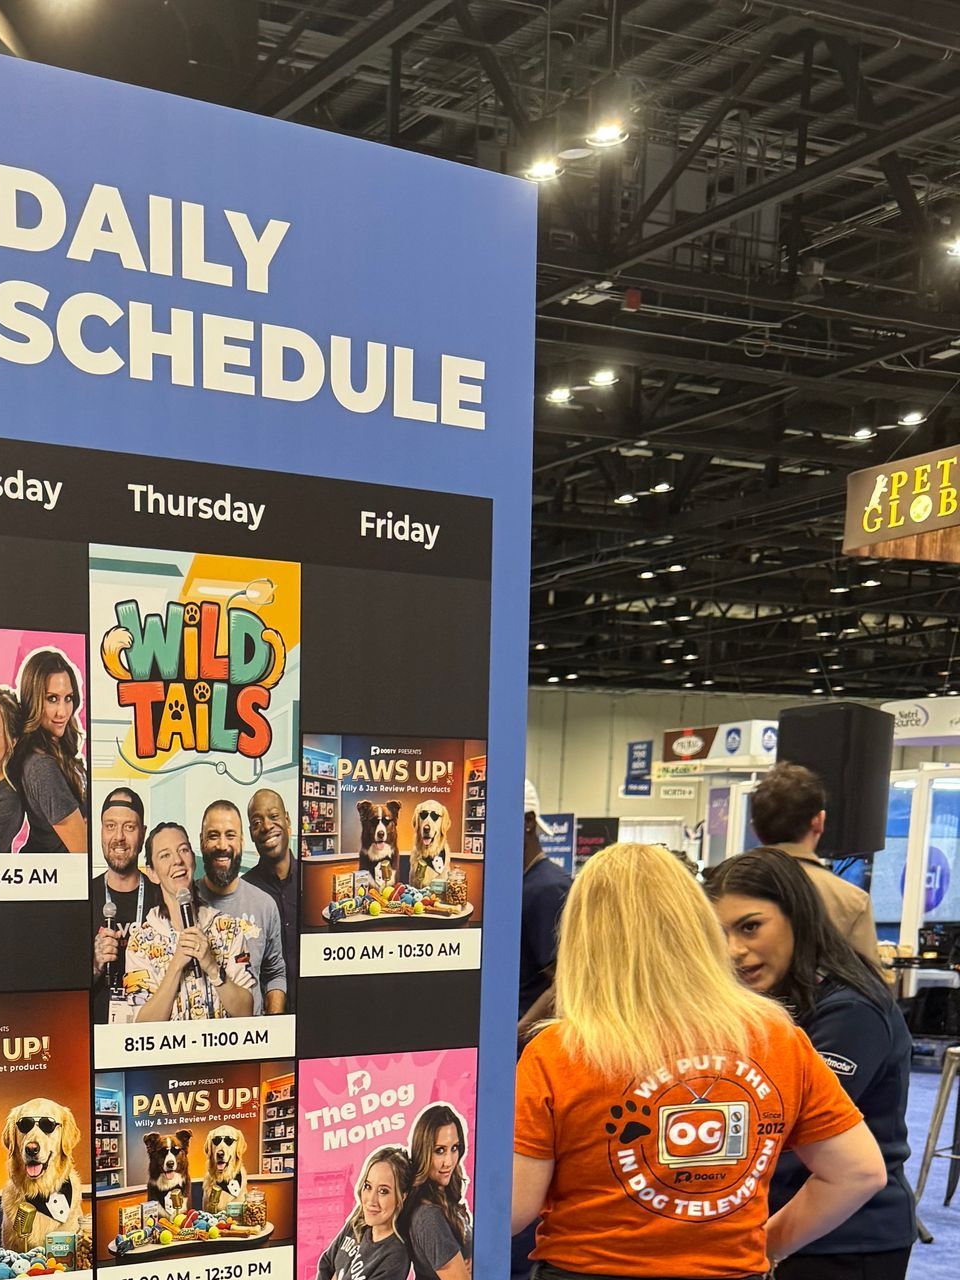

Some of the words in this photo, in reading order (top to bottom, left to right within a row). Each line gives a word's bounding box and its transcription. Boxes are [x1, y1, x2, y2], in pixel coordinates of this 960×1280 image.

[889, 457, 957, 500] PET
[128, 484, 265, 530] Thursday
[360, 510, 441, 549] Friday
[895, 718, 921, 728] ource
[337, 758, 409, 783] PAWS
[415, 760, 454, 785] UP!
[28, 868, 58, 885] AM
[323, 946, 356, 961] 9:00
[360, 945, 384, 960] AM
[397, 943, 434, 958] 10:30
[437, 942, 461, 957] AM
[3, 1036, 51, 1061] UP!
[124, 1036, 155, 1052] 8:15
[159, 1034, 186, 1050] AM
[201, 1031, 239, 1048] 11:00
[242, 1029, 268, 1045] AM
[10, 1063, 47, 1073] products
[634, 1067, 672, 1100] WE
[677, 1055, 727, 1075] PUT
[735, 1060, 771, 1100] THE
[132, 1089, 210, 1117] PAWS
[217, 1086, 260, 1110] UP!
[305, 1101, 357, 1131] The
[360, 1083, 415, 1120] Dog
[323, 1112, 406, 1151] Moms
[669, 1120, 723, 1146] OG
[757, 1122, 785, 1136] 2012
[617, 1149, 638, 1173] IN
[629, 1175, 669, 1210] DOG
[674, 1138, 776, 1217] TELEVISION
[694, 1172, 727, 1182] DOGTV
[248, 1261, 272, 1277] PM
